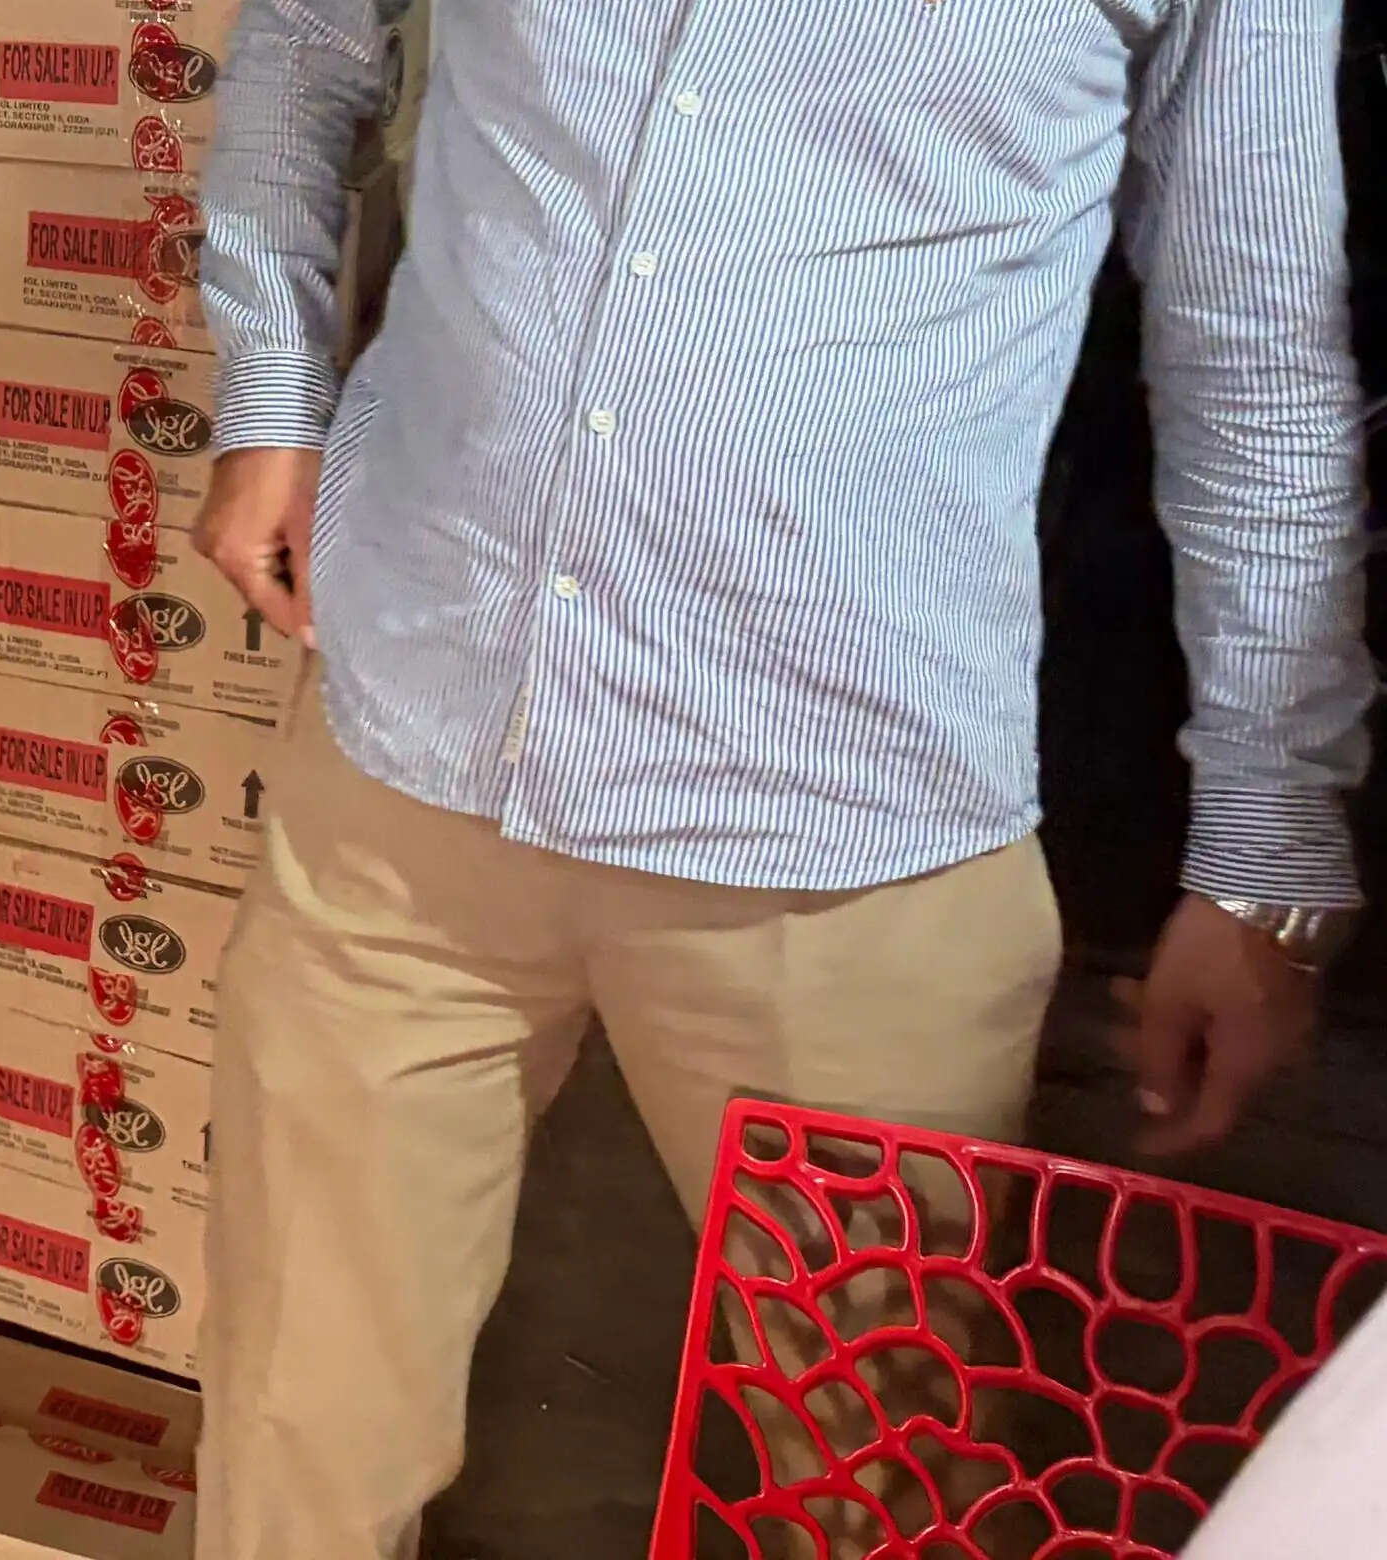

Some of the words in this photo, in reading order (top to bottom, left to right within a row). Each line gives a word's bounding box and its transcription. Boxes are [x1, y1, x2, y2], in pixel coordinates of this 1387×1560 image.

[2, 45, 31, 81] FOR
[34, 46, 70, 84] SALE
[74, 48, 87, 86] IN
[31, 222, 58, 260] FOR
[62, 228, 97, 265] SALE
[101, 231, 115, 267] IN
[2, 385, 30, 421] FOR
[34, 390, 68, 429] SALE
[71, 394, 86, 432] IN
[27, 584, 61, 622] SALE
[64, 589, 78, 624] IN
[29, 743, 62, 780] SALE
[65, 747, 79, 784] IN
[32, 1079, 46, 1114] IN
[11, 1228, 45, 1271] SALE
[47, 1242, 61, 1275] IN
